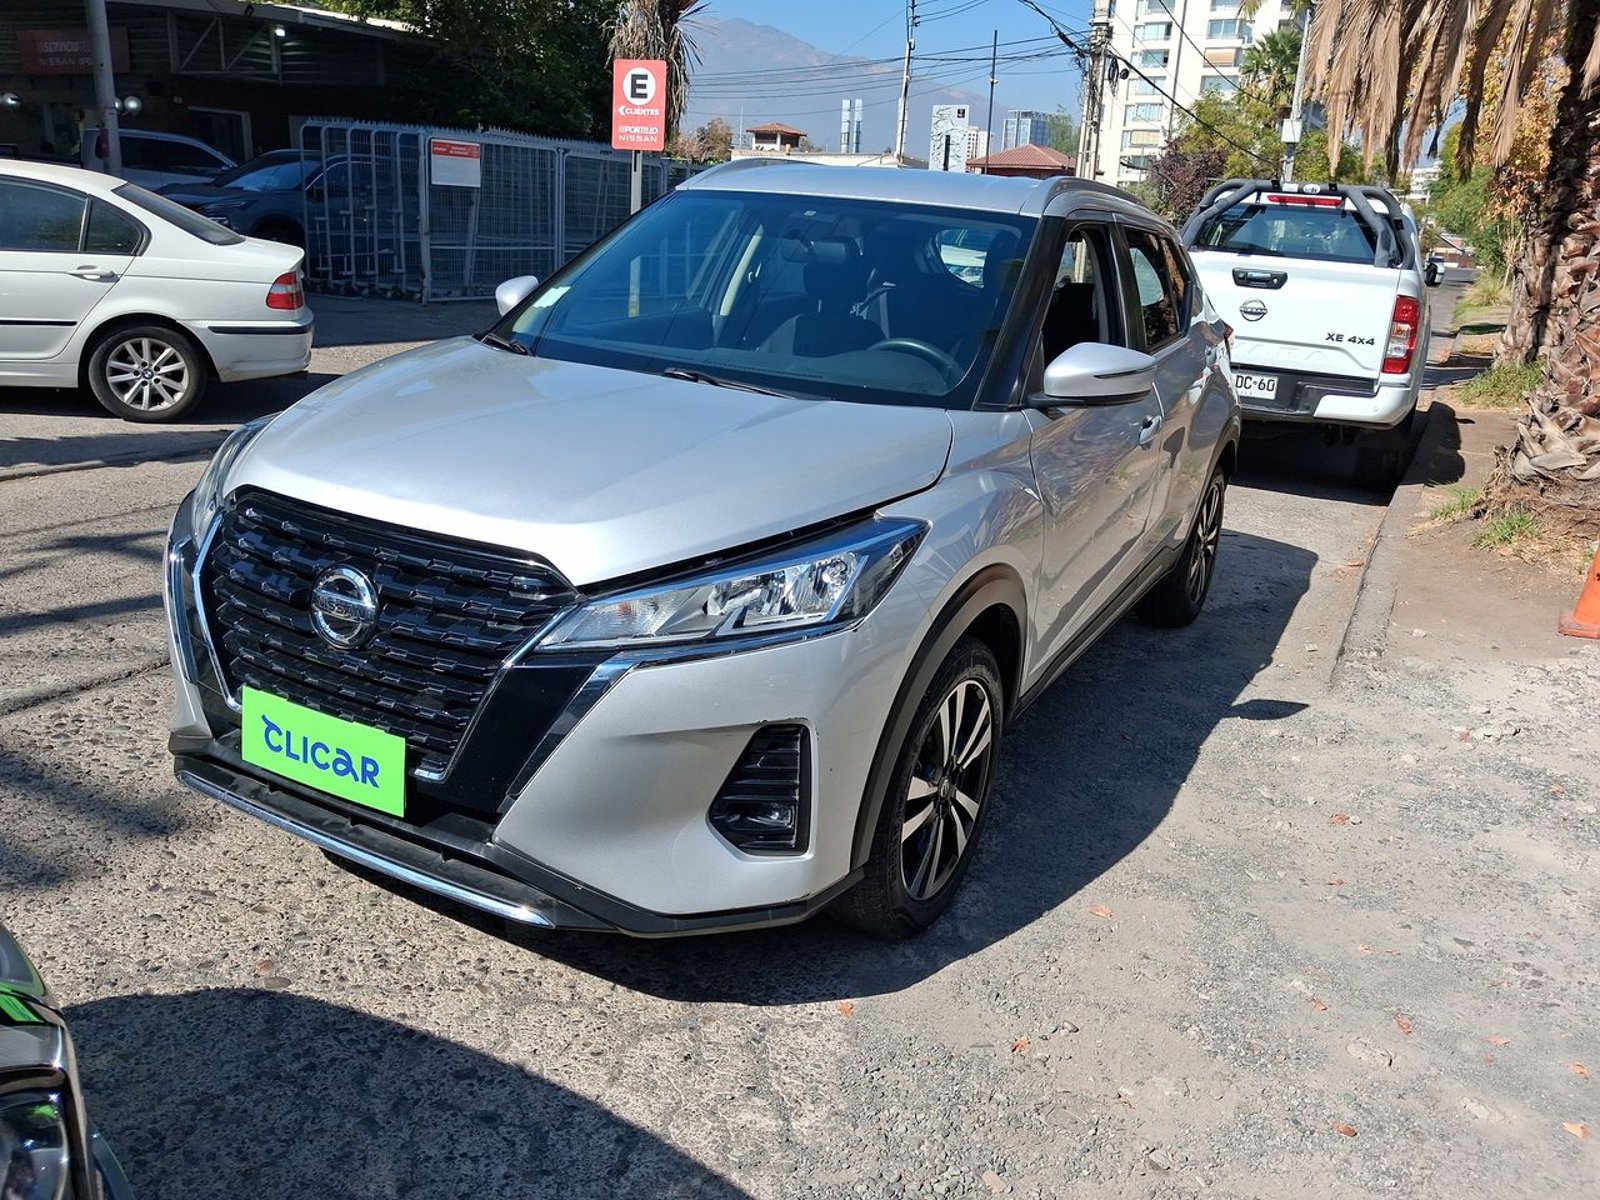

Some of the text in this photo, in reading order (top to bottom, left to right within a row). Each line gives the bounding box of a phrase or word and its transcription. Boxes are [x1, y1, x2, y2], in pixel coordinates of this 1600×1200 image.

[631, 74, 648, 98] E
[625, 108, 660, 116] CLIENTES
[619, 134, 657, 142] NISSAN
[1325, 332, 1344, 343] XE
